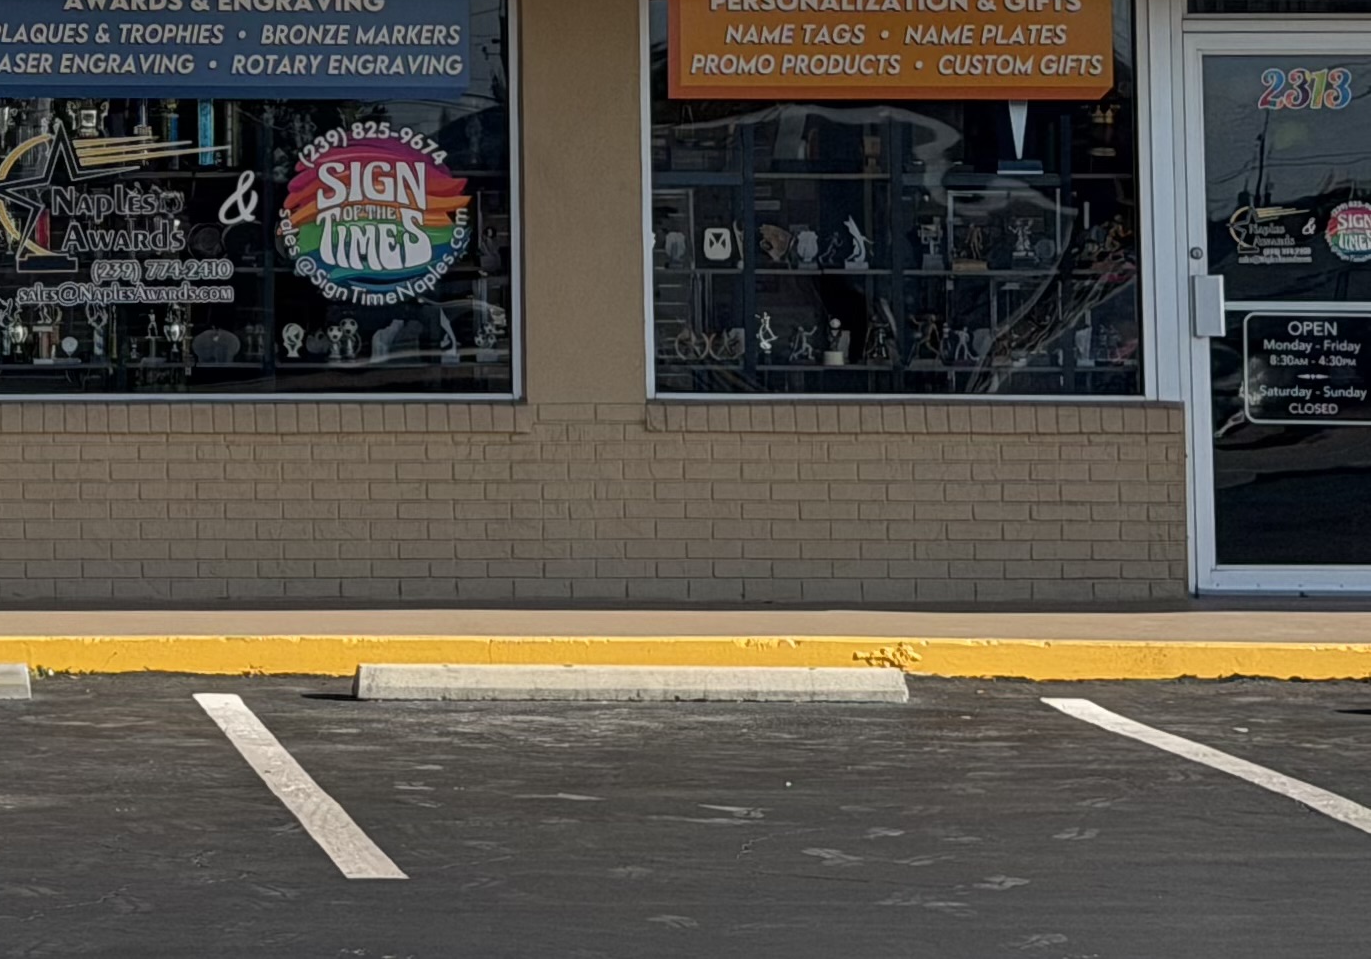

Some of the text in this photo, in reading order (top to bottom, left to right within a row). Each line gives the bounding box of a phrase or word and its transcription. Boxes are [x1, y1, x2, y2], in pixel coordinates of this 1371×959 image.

[94, 22, 111, 44] &
[118, 23, 225, 45] TROPHIES
[260, 24, 351, 45] BRONZE
[355, 24, 461, 46] MARKERS
[725, 23, 1068, 46] NAME TAGS NAME PLATES
[59, 53, 195, 75] ENGRAVING
[231, 54, 324, 75] ROTARY
[327, 54, 464, 76] ENGRAVING
[691, 53, 1104, 75] PROMO PRODUCTS CUSTOM GIFTS
[1258, 67, 1352, 109] 2313
[298, 121, 448, 168] (239) 825-9674
[218, 169, 259, 225] &
[317, 161, 427, 211] SIGN
[51, 184, 159, 224] Naples
[343, 205, 397, 221] OF THE
[61, 219, 186, 252] Awards
[1301, 216, 1317, 235] &
[316, 207, 433, 271] TIMES
[91, 258, 234, 284] (239) 774-2410
[1287, 321, 1338, 336] OPEN
[1263, 339, 1313, 354] Monday
[1323, 339, 1361, 355] Friday
[1269, 354, 1309, 366] 8:30AM
[1259, 384, 1313, 400] Saturday
[1323, 385, 1368, 401] Sunday
[1288, 403, 1339, 415] CLOSED
